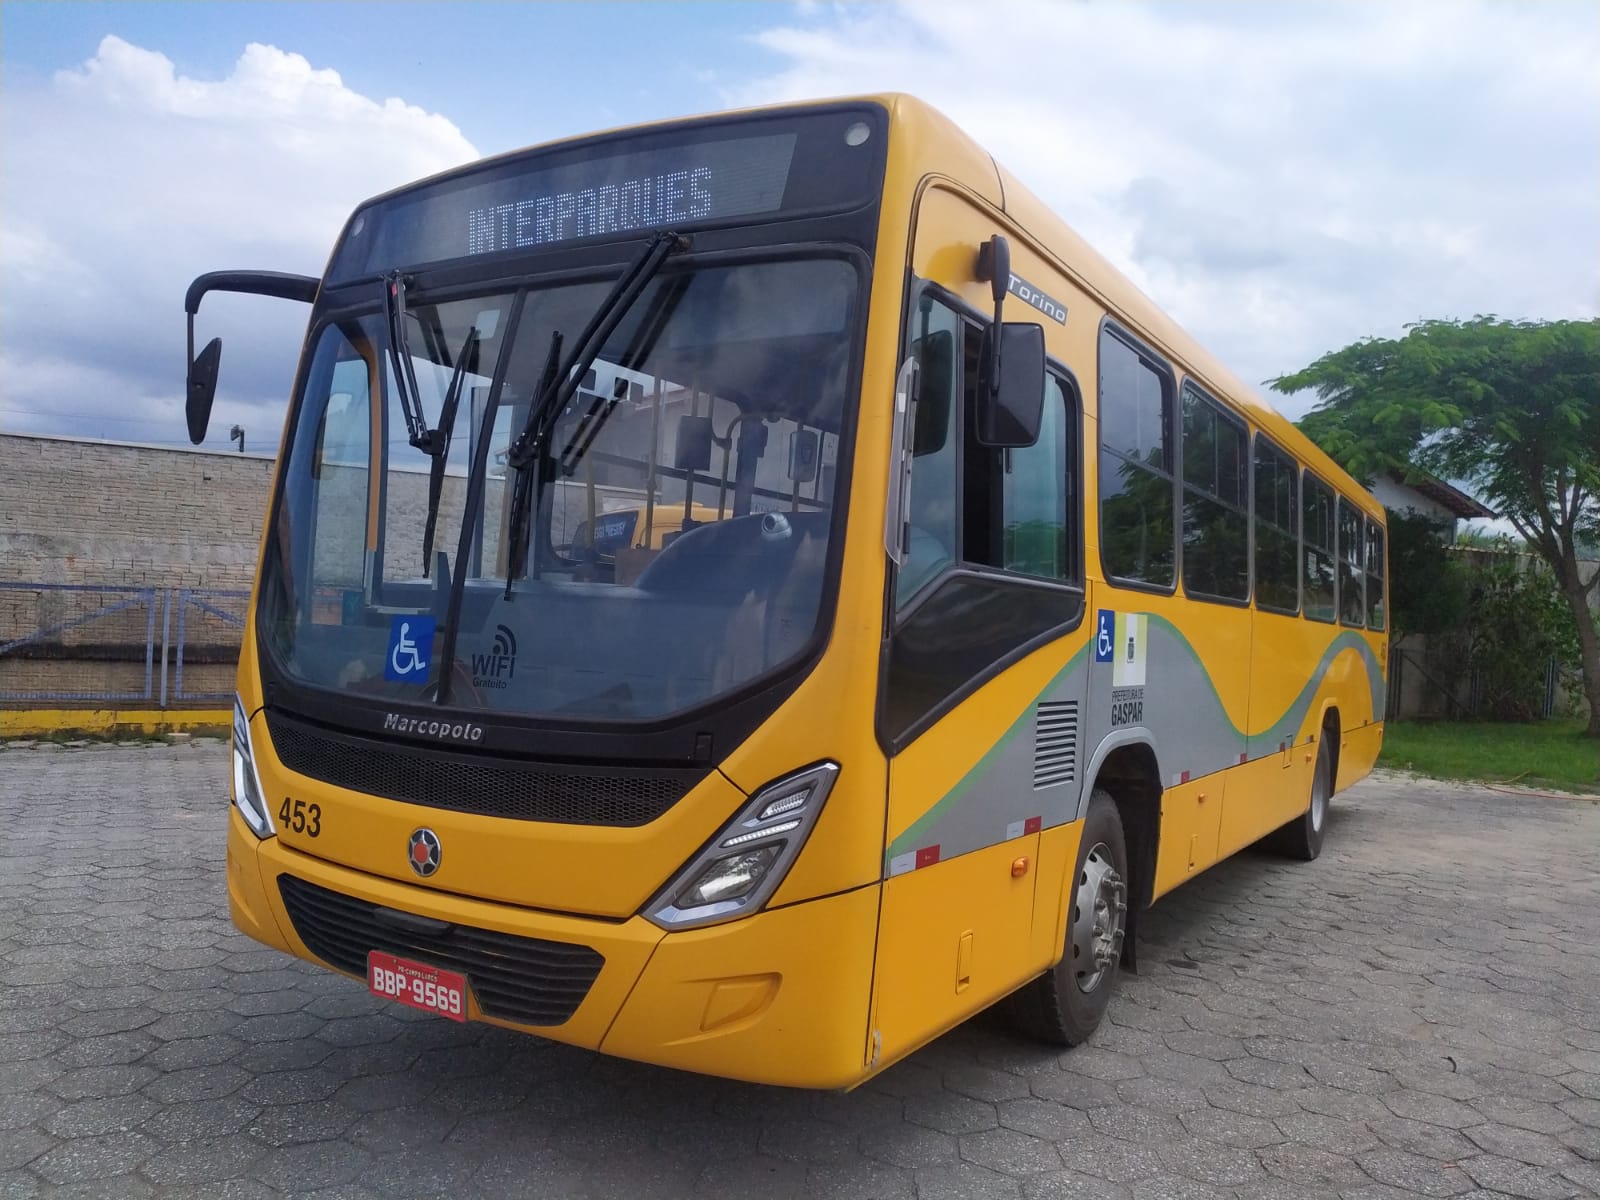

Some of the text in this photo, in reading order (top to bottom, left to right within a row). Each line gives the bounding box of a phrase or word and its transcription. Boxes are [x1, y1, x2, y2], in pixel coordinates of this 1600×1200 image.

[469, 167, 712, 255] INTERPARQUES
[1008, 274, 1066, 322] Torino
[472, 654, 516, 679] WIFI
[473, 677, 507, 689] Gratuito
[384, 713, 482, 741] Marcopolo
[1111, 701, 1143, 726] GASPAR
[279, 797, 322, 838] 453
